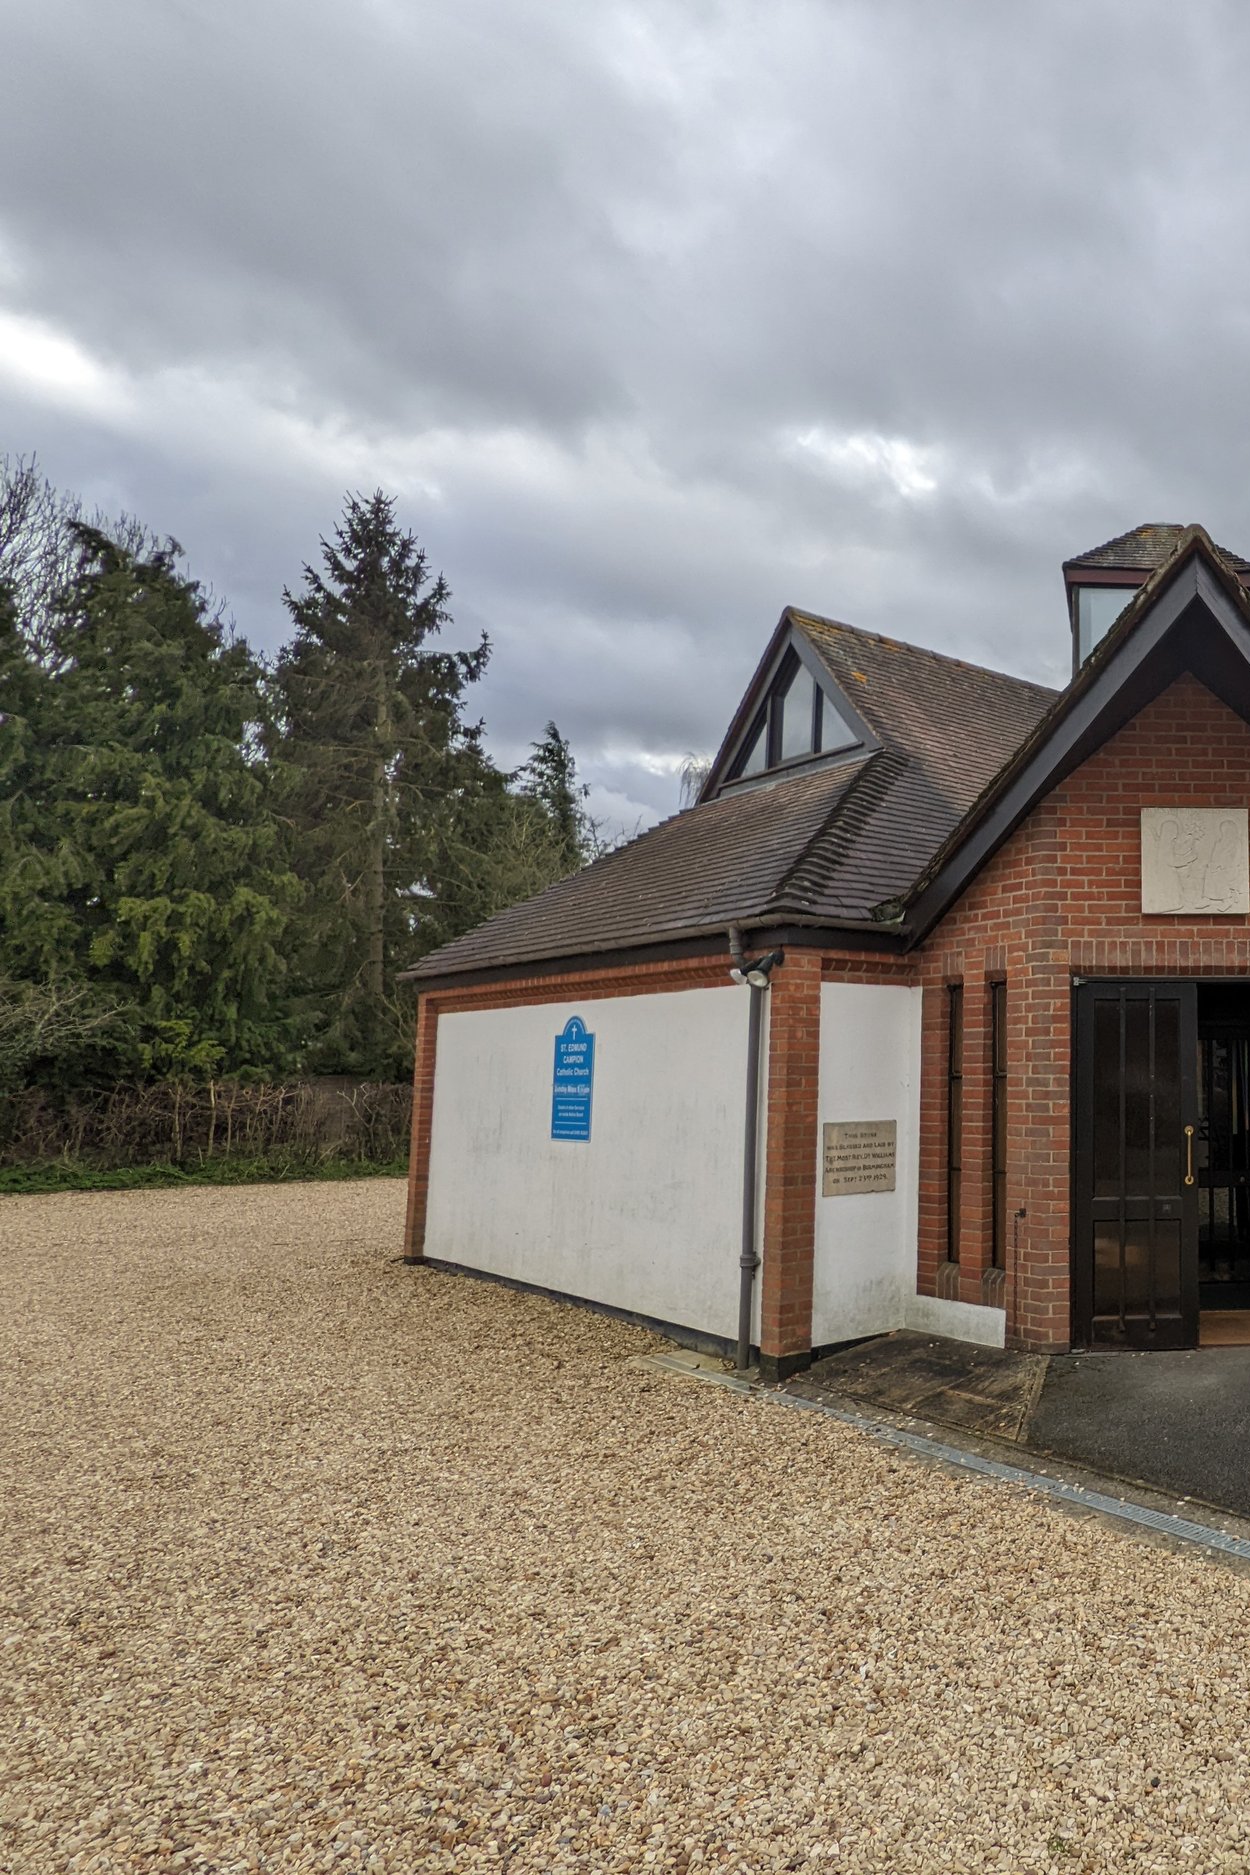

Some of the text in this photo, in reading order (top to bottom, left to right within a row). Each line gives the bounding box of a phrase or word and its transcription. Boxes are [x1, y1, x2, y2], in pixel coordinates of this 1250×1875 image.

[568, 1043, 587, 1052] EDMUND
[563, 1055, 584, 1064] CAMPION
[556, 1067, 589, 1076] Catholic Church
